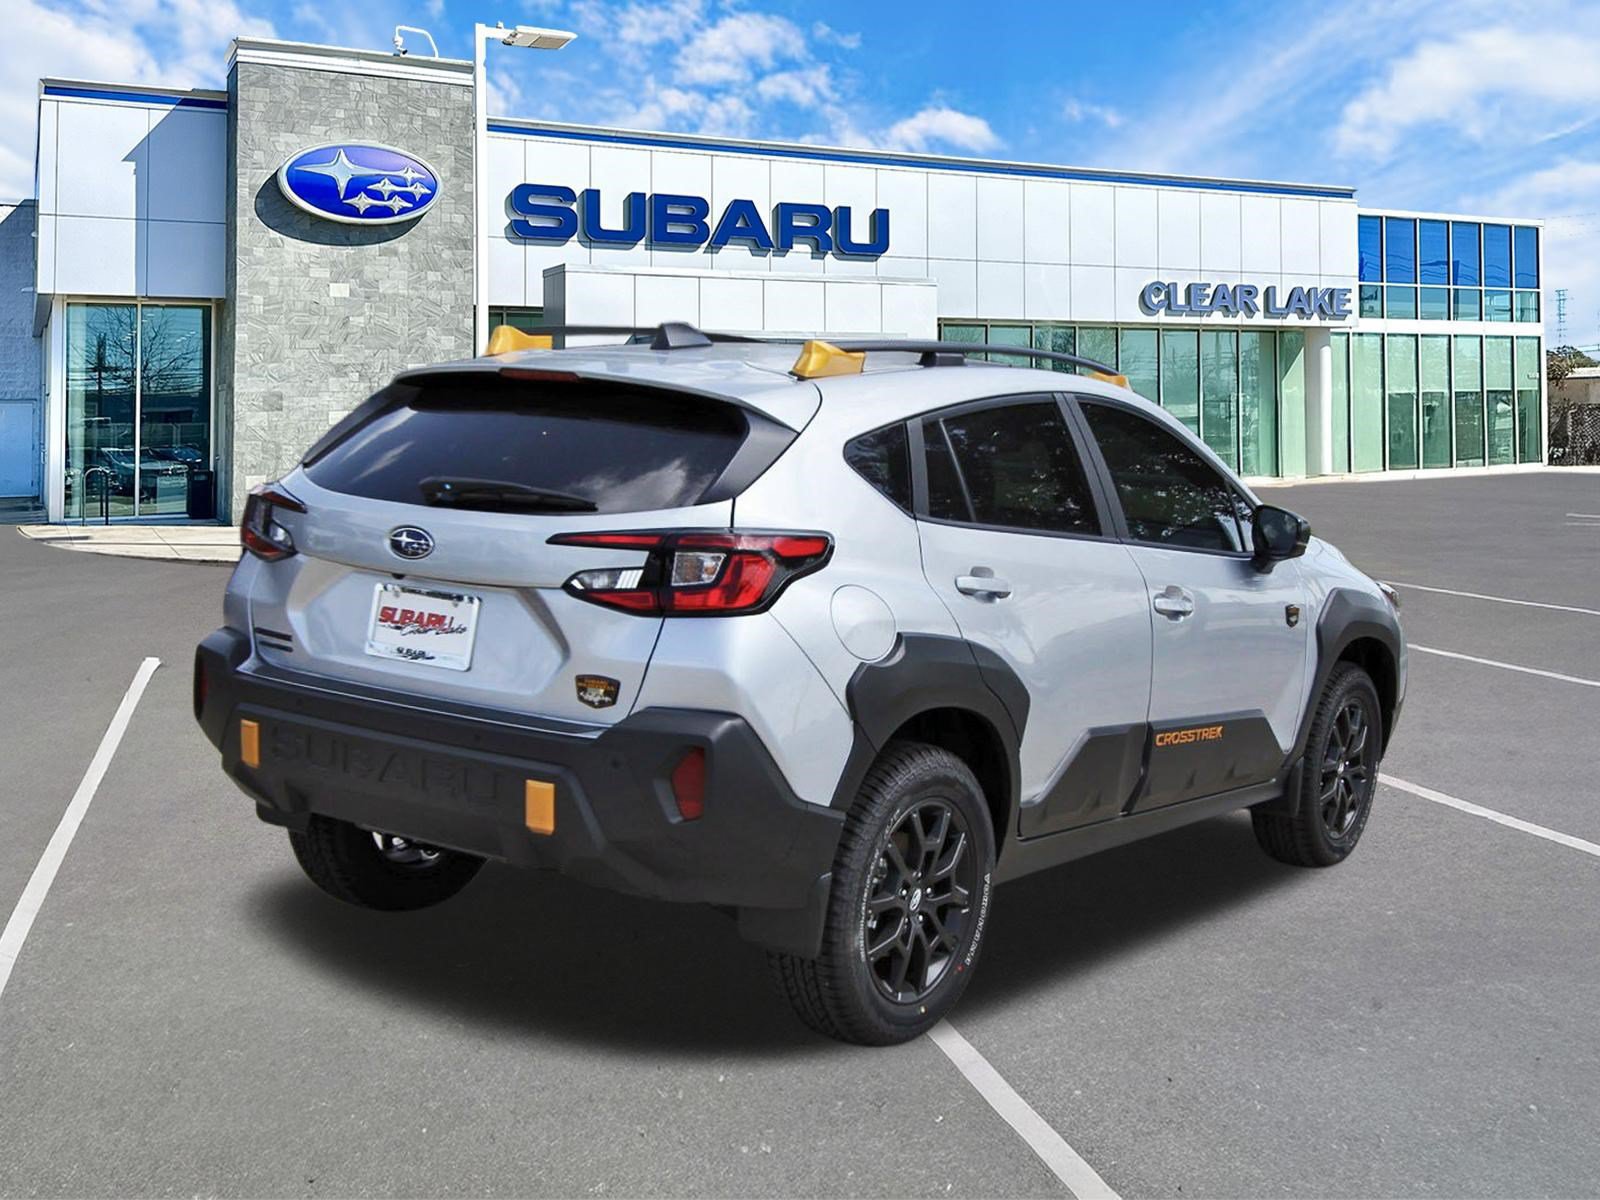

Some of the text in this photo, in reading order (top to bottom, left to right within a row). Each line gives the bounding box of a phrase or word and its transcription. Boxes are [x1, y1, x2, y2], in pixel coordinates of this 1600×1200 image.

[506, 183, 889, 259] SUBARU
[1140, 281, 1352, 319] CLEAR LAKE
[378, 606, 454, 630] SUBARU
[1155, 726, 1223, 746] CROSSTREK
[271, 725, 500, 802] SUBARU
